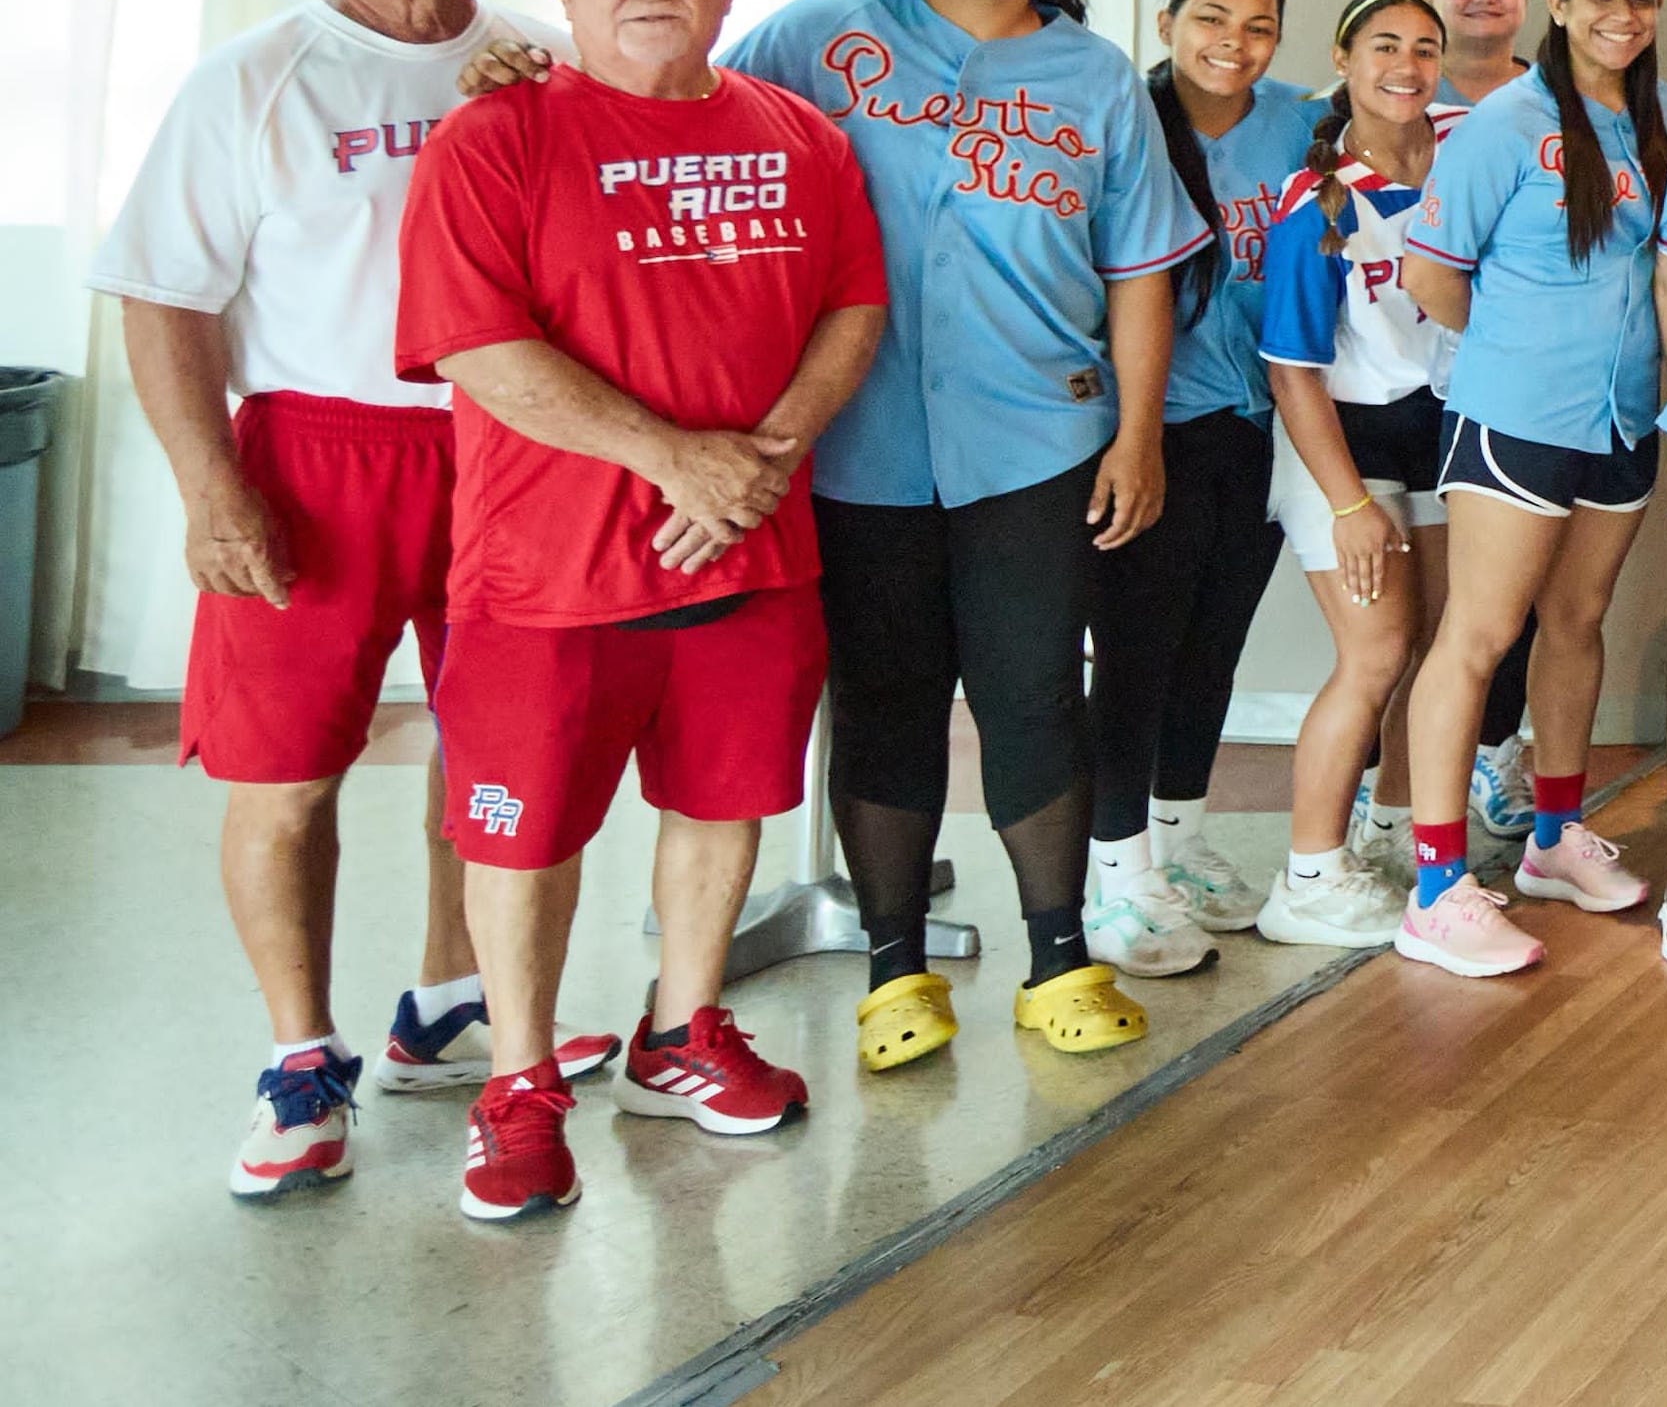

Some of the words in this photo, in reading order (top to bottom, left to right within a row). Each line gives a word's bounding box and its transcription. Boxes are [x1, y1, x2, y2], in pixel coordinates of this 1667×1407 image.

[821, 30, 1098, 159] Puerto
[599, 152, 788, 194] PUERTO
[950, 129, 1086, 218] Rico
[669, 183, 786, 222] RICO
[616, 218, 807, 252] BASEBALL
[468, 783, 524, 837] PR
